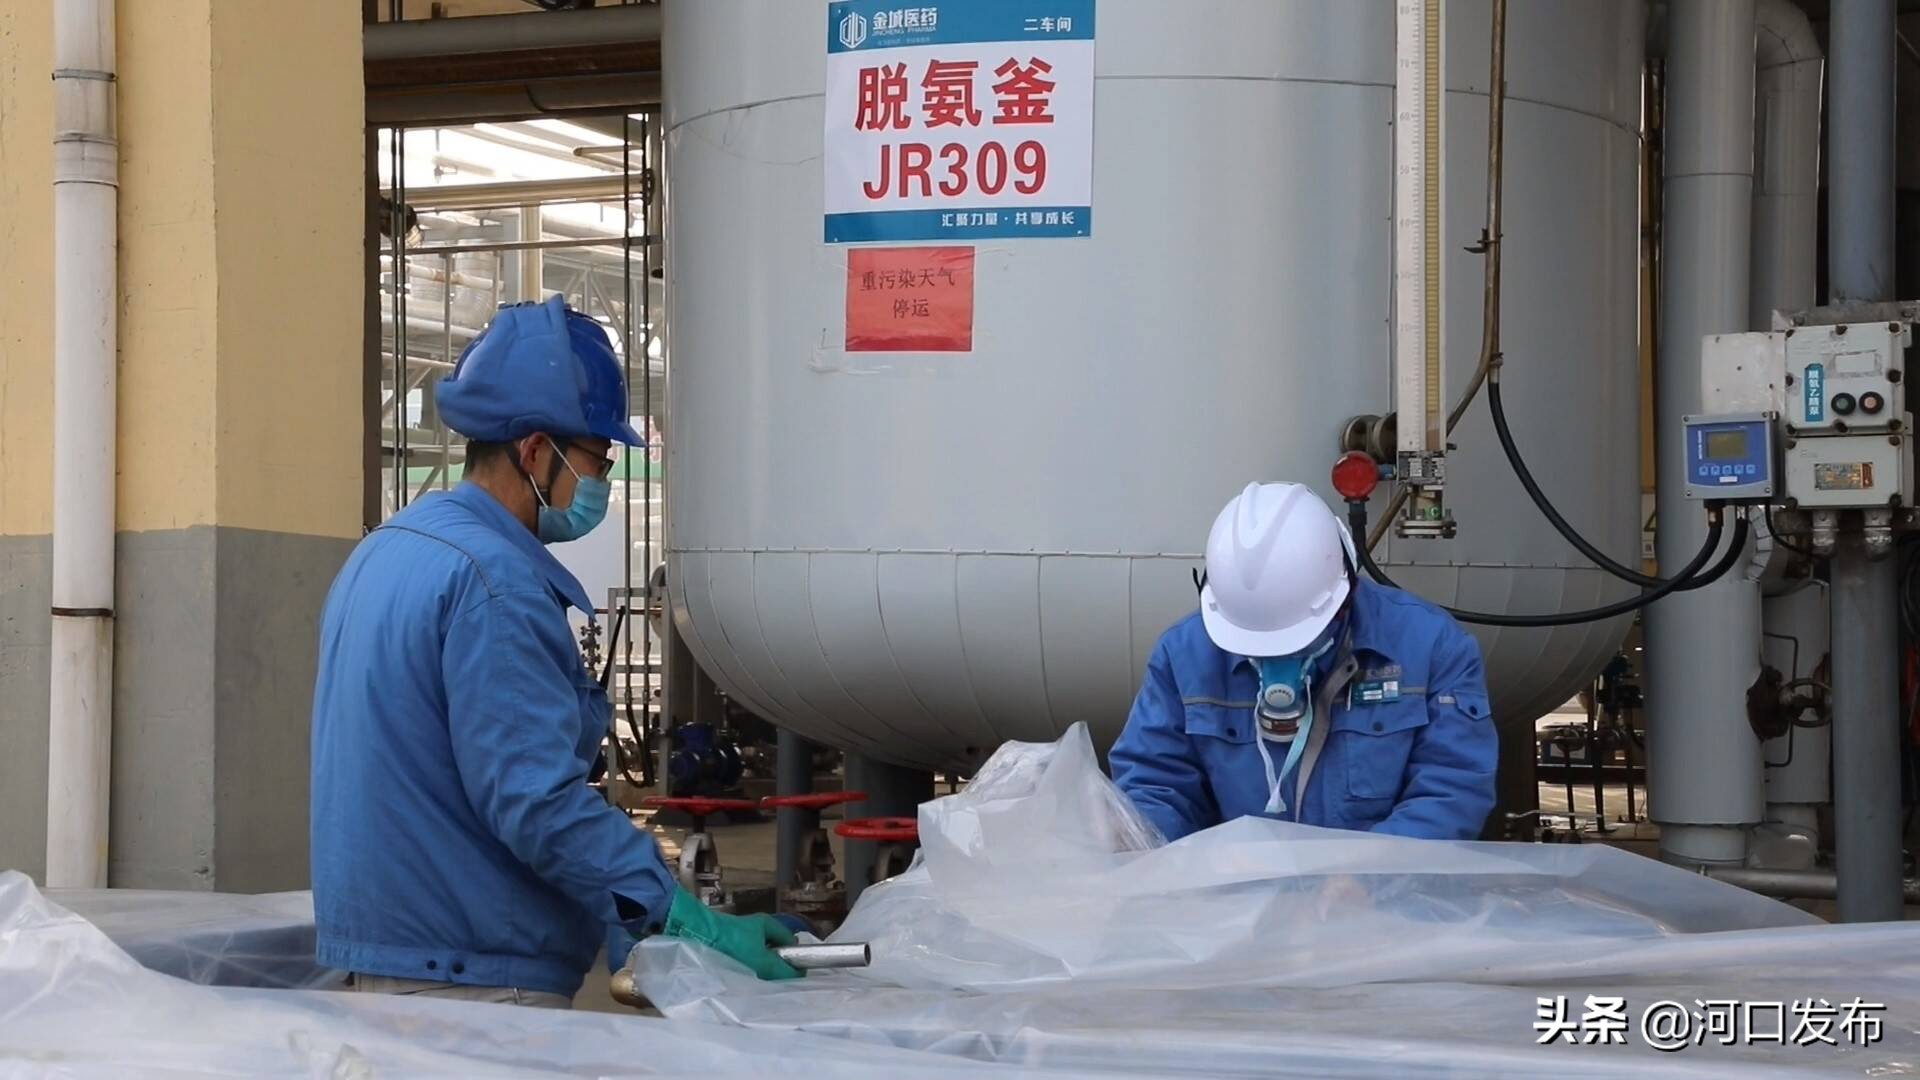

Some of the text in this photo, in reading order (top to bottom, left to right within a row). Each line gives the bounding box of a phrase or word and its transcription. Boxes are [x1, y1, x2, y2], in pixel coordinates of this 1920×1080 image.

[872, 7, 938, 30] 金城医药
[1023, 16, 1072, 33] 二车间
[855, 56, 1056, 131] 脱氨釜
[863, 140, 1047, 200] JR309
[860, 267, 956, 291] 重污染天气
[892, 299, 931, 319] 停运
